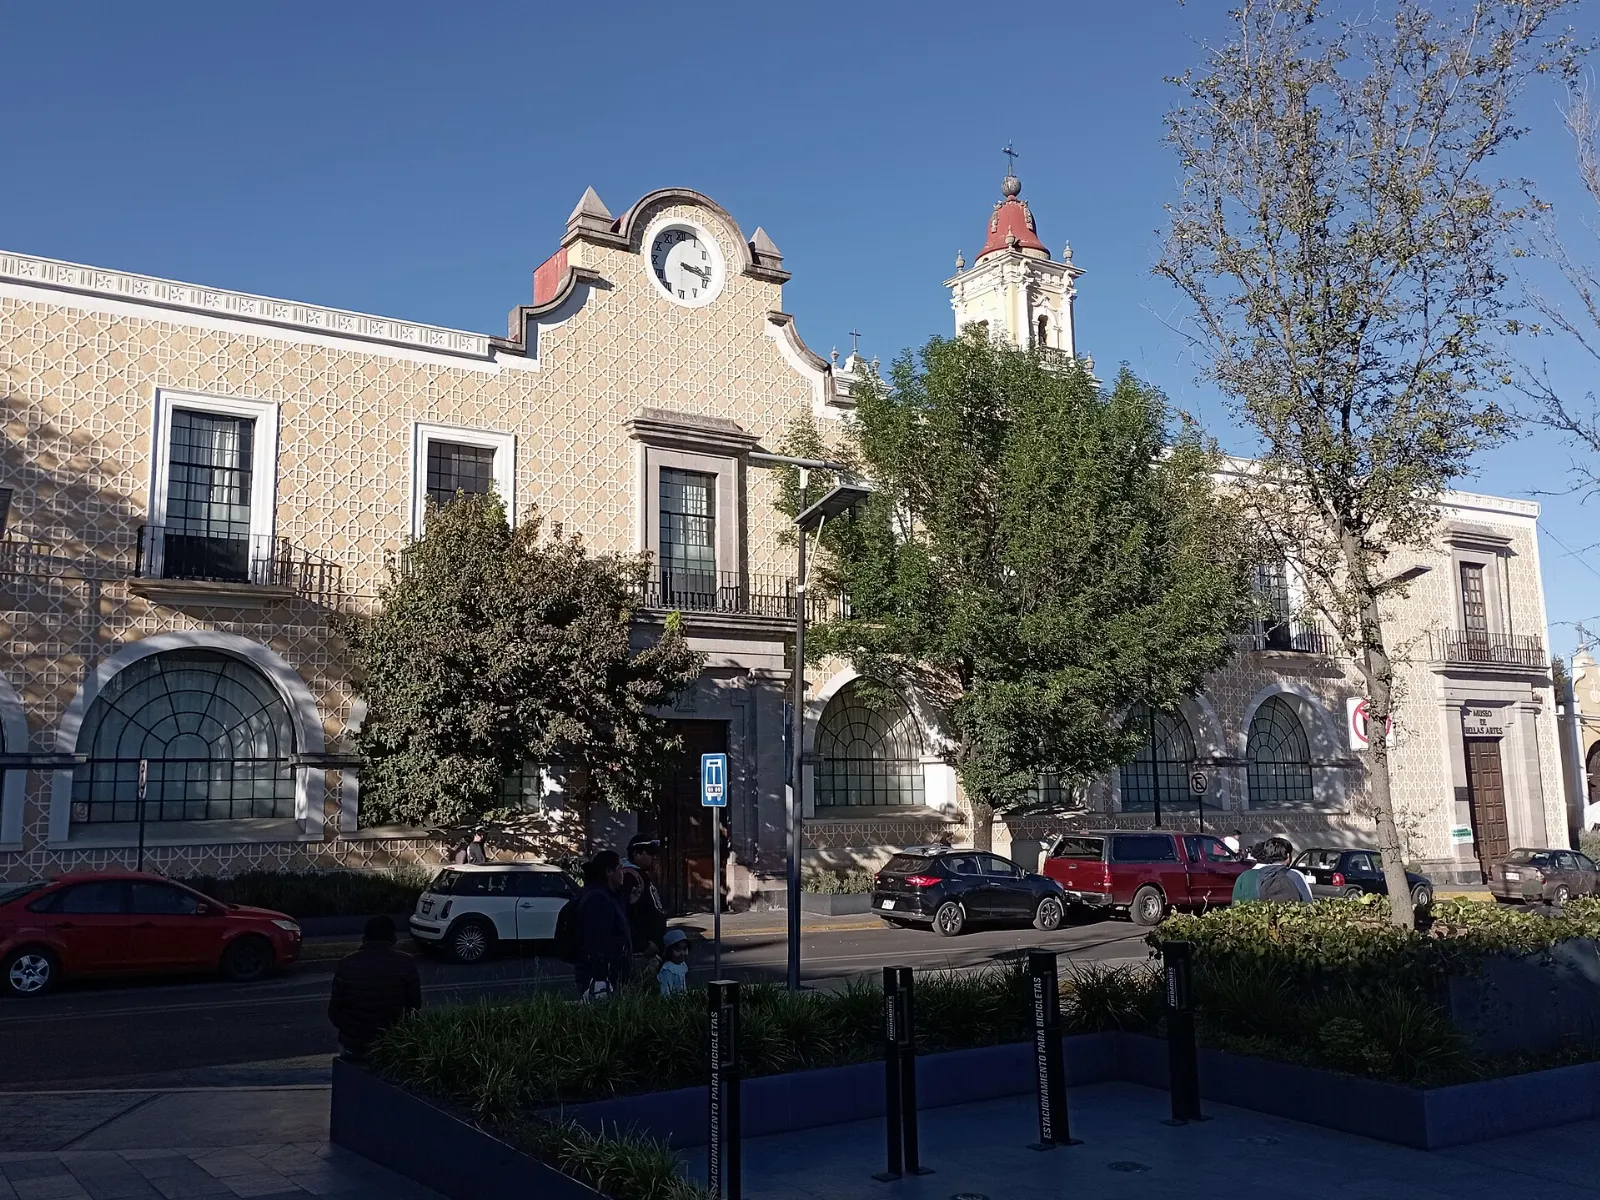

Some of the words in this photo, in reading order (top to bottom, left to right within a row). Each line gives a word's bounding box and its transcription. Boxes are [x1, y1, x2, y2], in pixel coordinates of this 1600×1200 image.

[664, 233, 673, 244] XI
[1465, 726, 1484, 734] BELLAS
[1479, 718, 1487, 726] DE
[1033, 977, 1044, 1027] BICICLETAS
[710, 1011, 719, 1070] BICICLETAS
[1036, 1029, 1046, 1053] PARA
[710, 1072, 719, 1100] PARA
[1038, 1055, 1052, 1139] ESTACIONAMIENTO
[710, 1102, 719, 1189] TACIONAMIENTO
